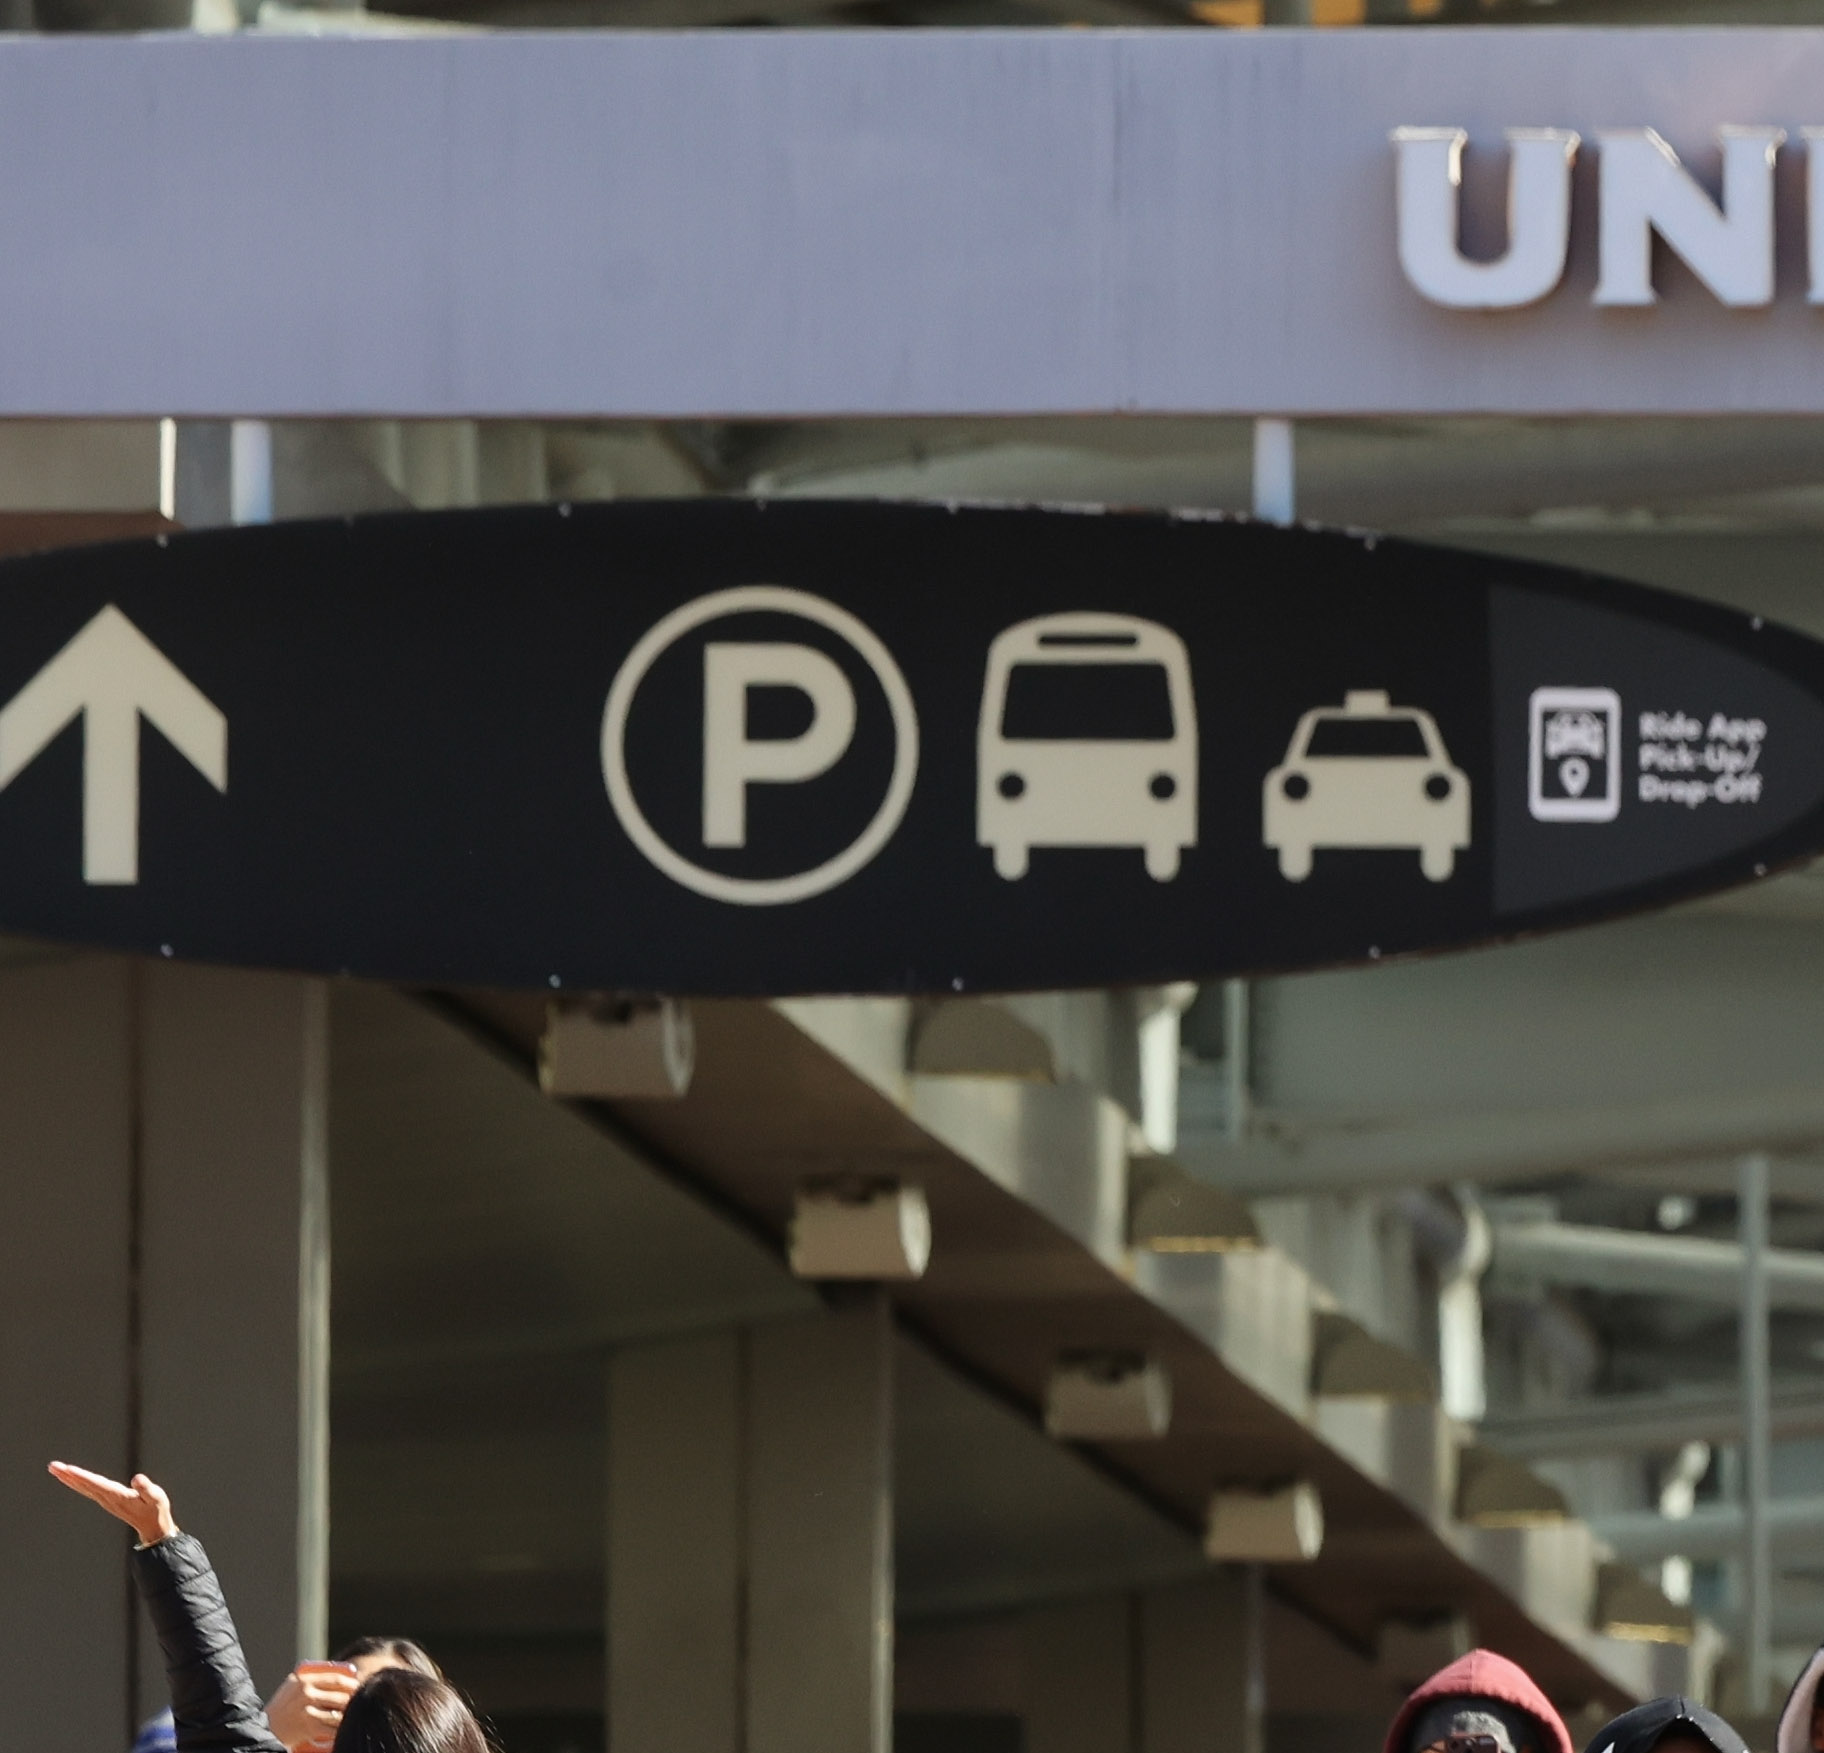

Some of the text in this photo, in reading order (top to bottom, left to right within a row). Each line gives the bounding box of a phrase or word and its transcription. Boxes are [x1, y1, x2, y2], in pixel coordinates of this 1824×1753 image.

[703, 642, 857, 848] P
[1638, 711, 1767, 748] Ride App
[1638, 772, 1763, 810] Drop-Off
